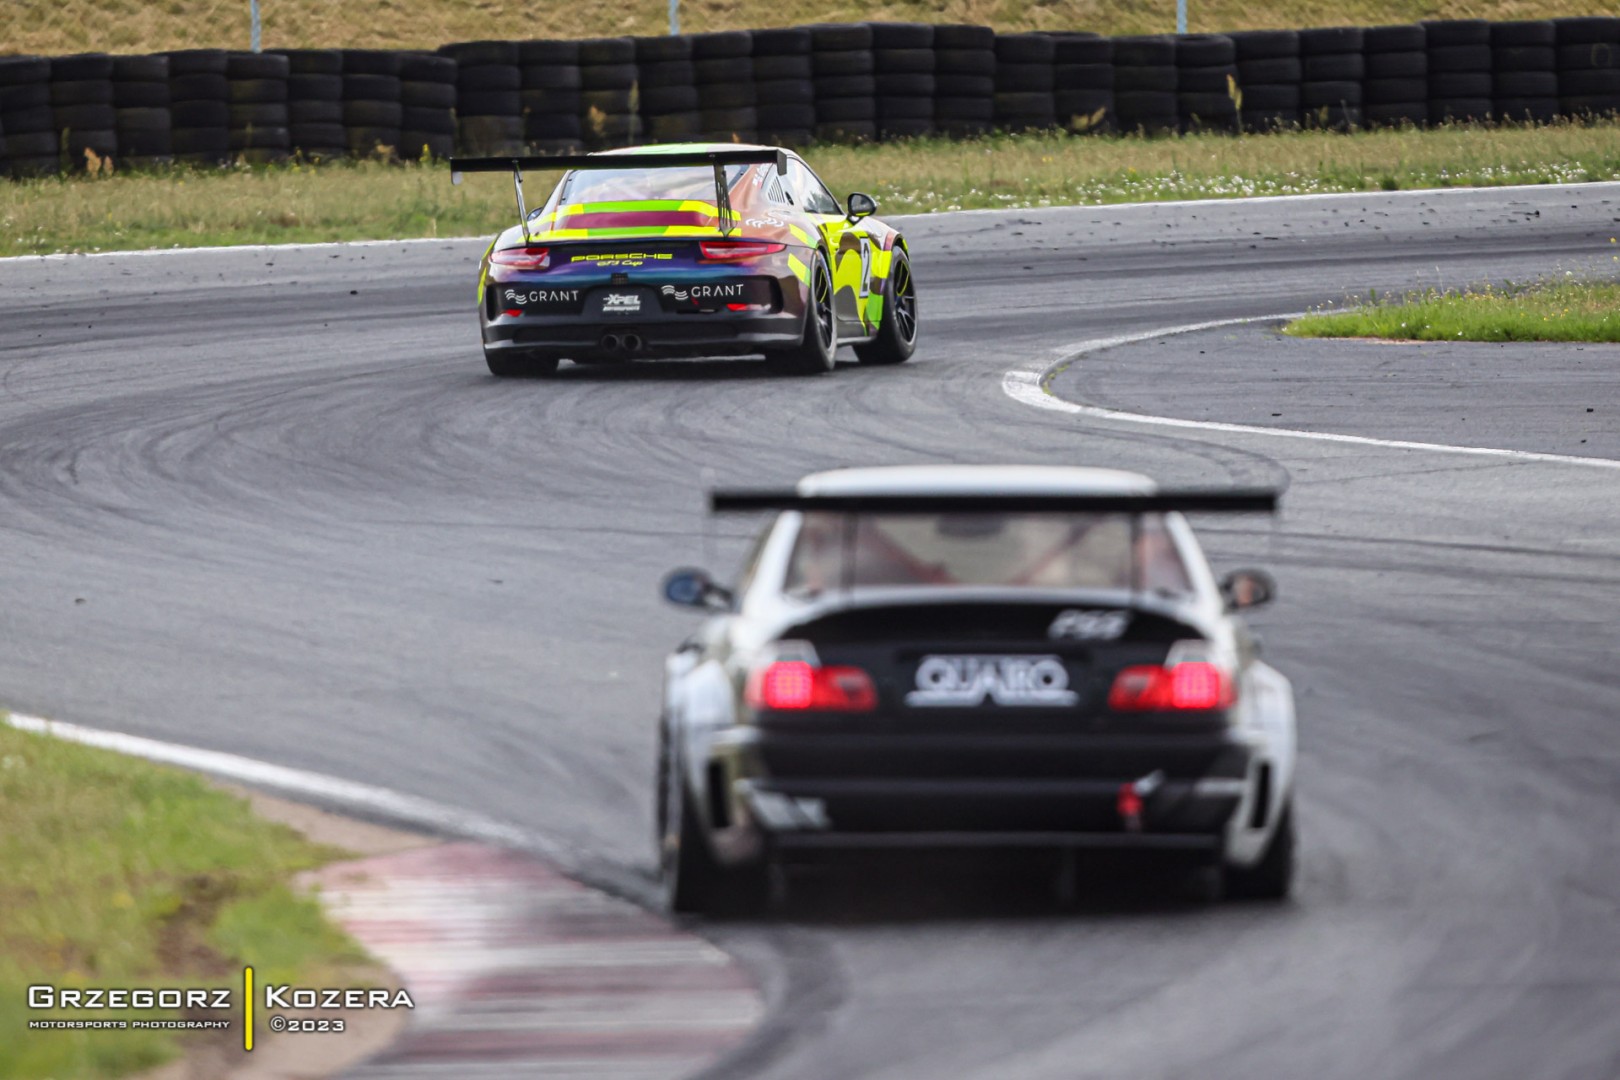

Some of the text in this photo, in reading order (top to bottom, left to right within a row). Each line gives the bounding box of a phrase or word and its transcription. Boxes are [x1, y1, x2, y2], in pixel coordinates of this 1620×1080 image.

[571, 253, 673, 262] PORSCHE
[861, 240, 870, 292] 2
[529, 291, 579, 302] GRANT
[692, 285, 744, 298] GRANT
[605, 294, 641, 305] XPEL
